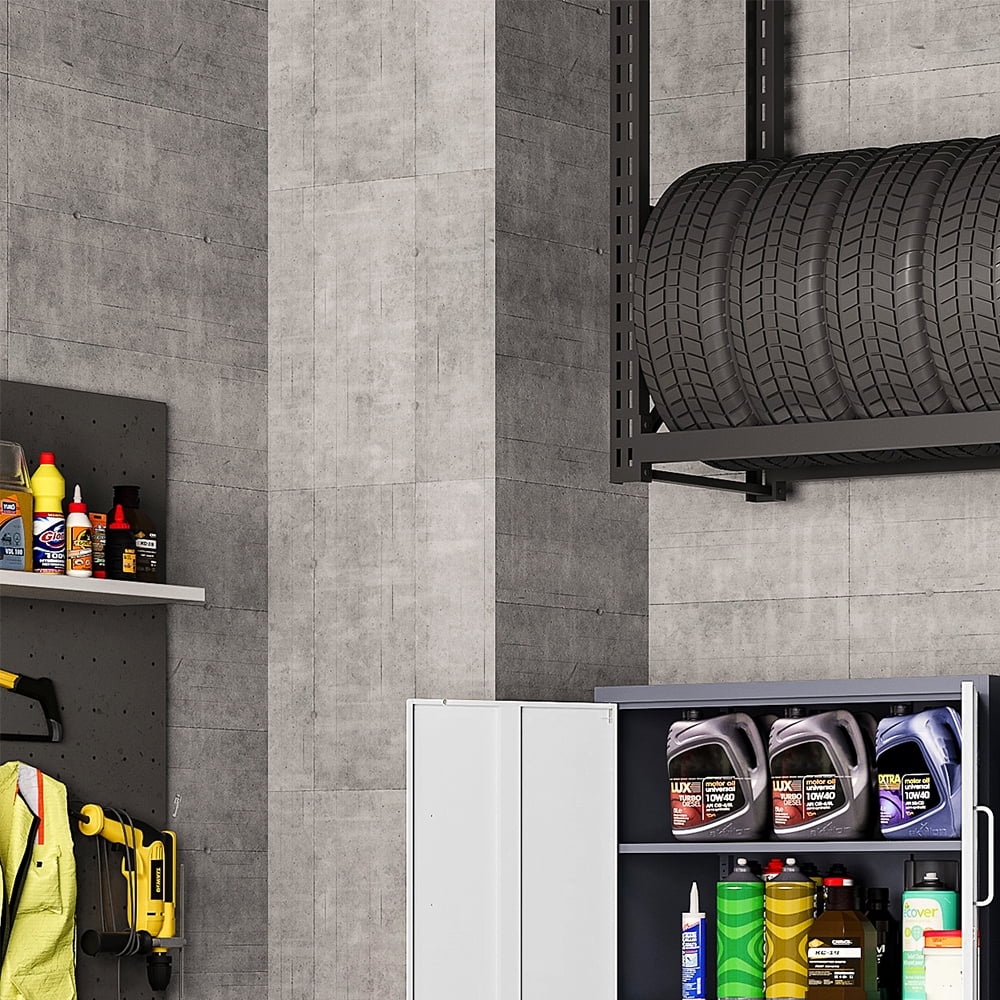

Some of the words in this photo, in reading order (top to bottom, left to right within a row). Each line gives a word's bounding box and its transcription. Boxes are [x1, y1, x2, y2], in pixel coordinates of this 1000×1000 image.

[706, 793, 735, 802] 10W40
[806, 792, 835, 801] 10W40
[904, 791, 930, 800] 10W40
